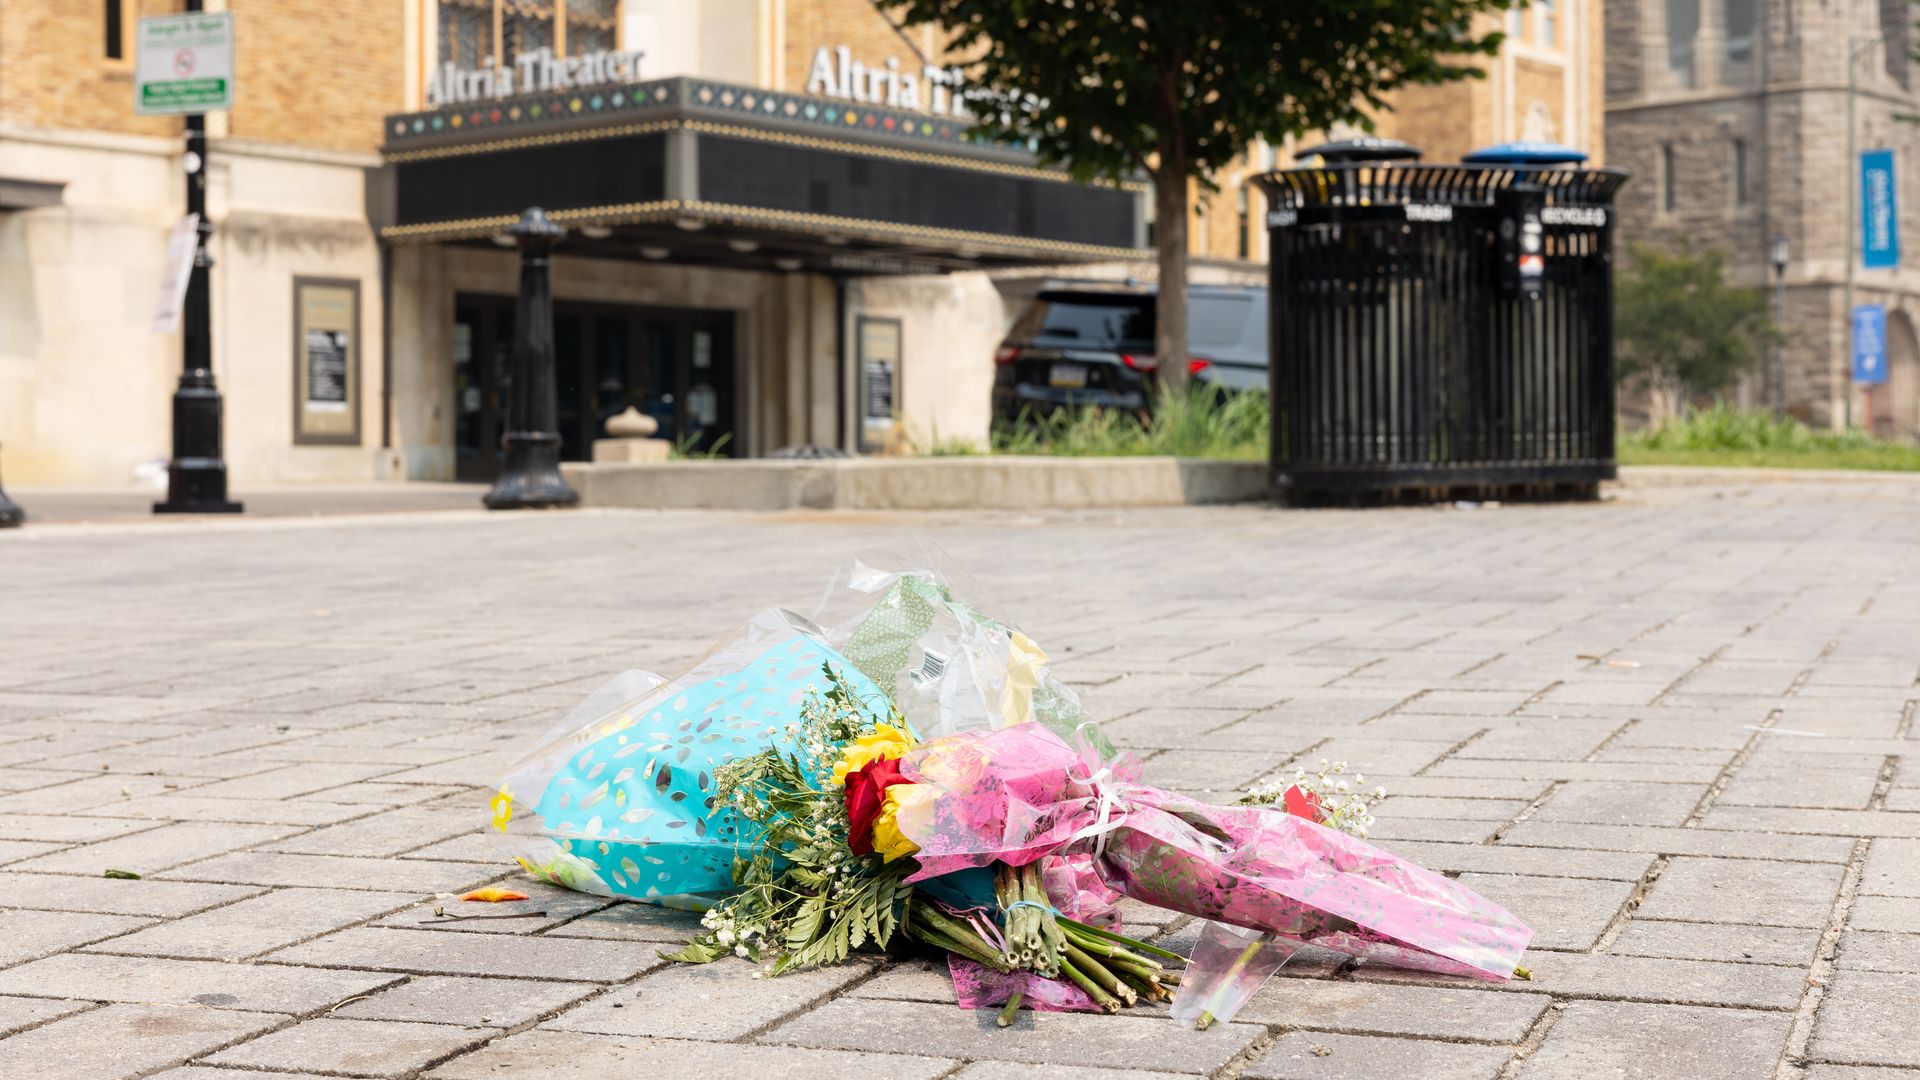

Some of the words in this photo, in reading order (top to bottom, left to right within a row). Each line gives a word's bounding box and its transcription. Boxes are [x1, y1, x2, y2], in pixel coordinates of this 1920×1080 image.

[428, 57, 514, 105] Altria
[515, 47, 644, 94] Theater
[806, 45, 921, 112] Altria
[1403, 204, 1453, 222] TRASH
